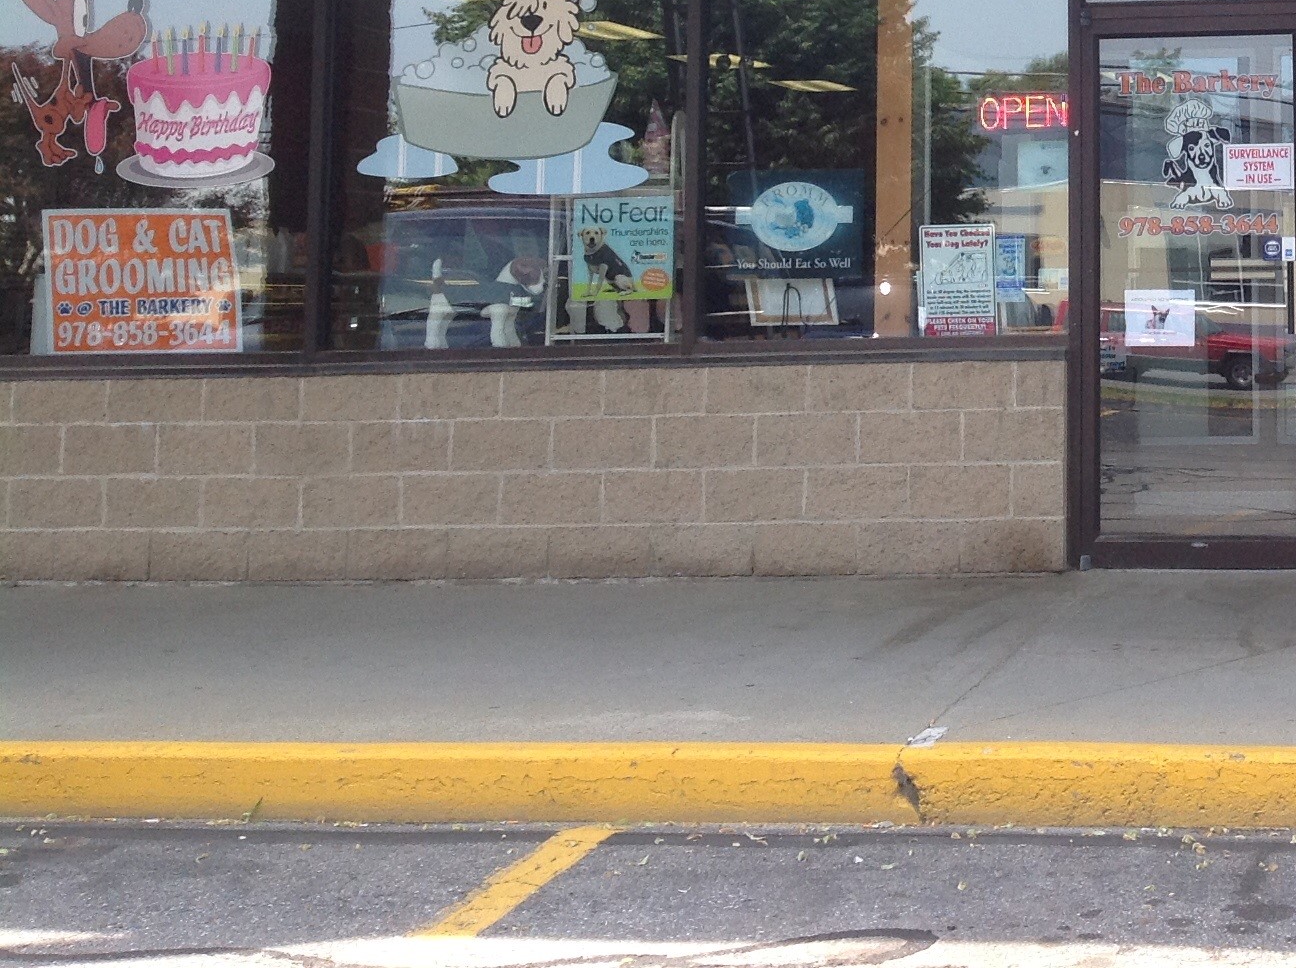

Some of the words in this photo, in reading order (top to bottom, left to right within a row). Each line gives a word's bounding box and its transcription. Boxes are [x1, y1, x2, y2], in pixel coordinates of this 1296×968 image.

[1116, 71, 1166, 95] The
[1172, 69, 1279, 98] Barkery
[981, 94, 1068, 129] OPEN
[137, 112, 187, 141] Happy
[189, 111, 259, 140] Birthday
[1229, 148, 1288, 159] SURVEILLANCE
[1243, 162, 1274, 171] SYSTEM
[1257, 173, 1272, 183] USE
[581, 202, 613, 224] No
[619, 202, 668, 223] Fear.
[924, 229, 943, 237] Have
[1118, 213, 1279, 237] 978-858-3644
[53, 218, 119, 255] DOG
[132, 218, 158, 253] &
[169, 218, 223, 253] CAT
[943, 240, 959, 249] Dog
[961, 239, 988, 249] Lately?
[736, 258, 755, 270] You
[758, 258, 792, 269] Should
[795, 258, 811, 269] Eat
[814, 259, 826, 268] So
[828, 257, 851, 268] Well
[55, 257, 232, 295] GROOMING
[98, 298, 131, 316] THE
[135, 296, 213, 317] BARKERY
[57, 320, 231, 347] 978-858-3644
